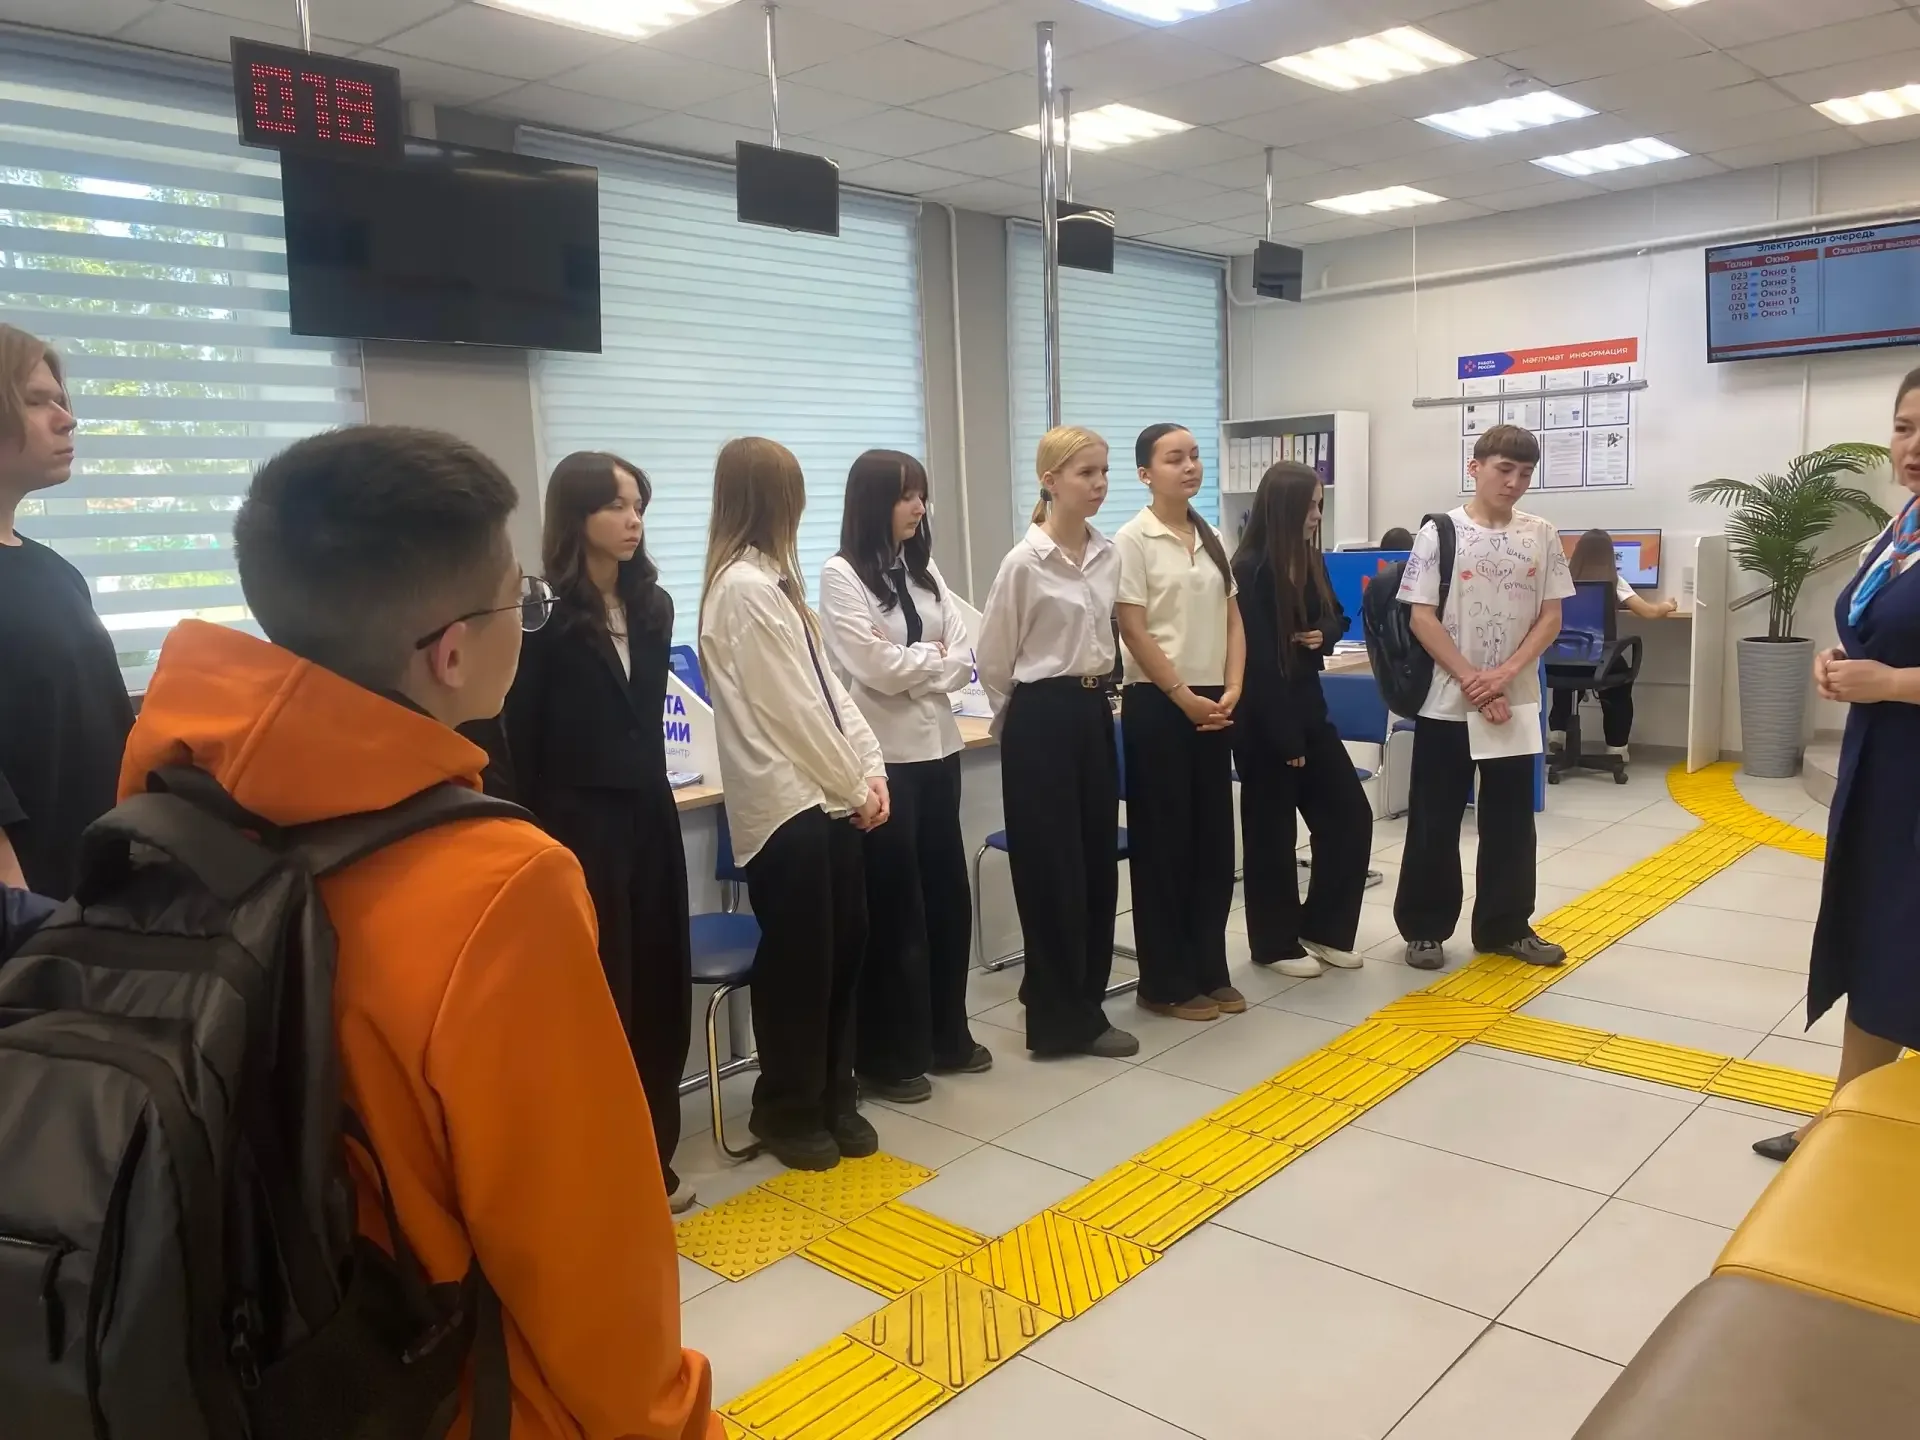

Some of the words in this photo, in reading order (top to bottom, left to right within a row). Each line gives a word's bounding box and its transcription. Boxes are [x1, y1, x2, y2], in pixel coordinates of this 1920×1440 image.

[1757, 236, 1826, 252] Электронная
[1829, 230, 1875, 242] очередь
[1832, 243, 1884, 255] Ожидайте
[1725, 260, 1753, 269] Талон
[1765, 255, 1790, 264] Окно
[1730, 271, 1748, 281] 023
[1761, 268, 1787, 277] Окно
[1731, 282, 1748, 291] 022
[1761, 279, 1787, 287] Окно
[1731, 292, 1748, 301] 021
[1761, 289, 1787, 298] Окно
[1728, 302, 1746, 311] 020
[1758, 299, 1784, 308] Окно
[1731, 312, 1749, 321] 018
[1761, 309, 1788, 318] Окно
[1569, 347, 1628, 359] ИНФОРМАЦИЯ
[665, 694, 686, 716] ТА
[663, 720, 691, 743] ИИ
